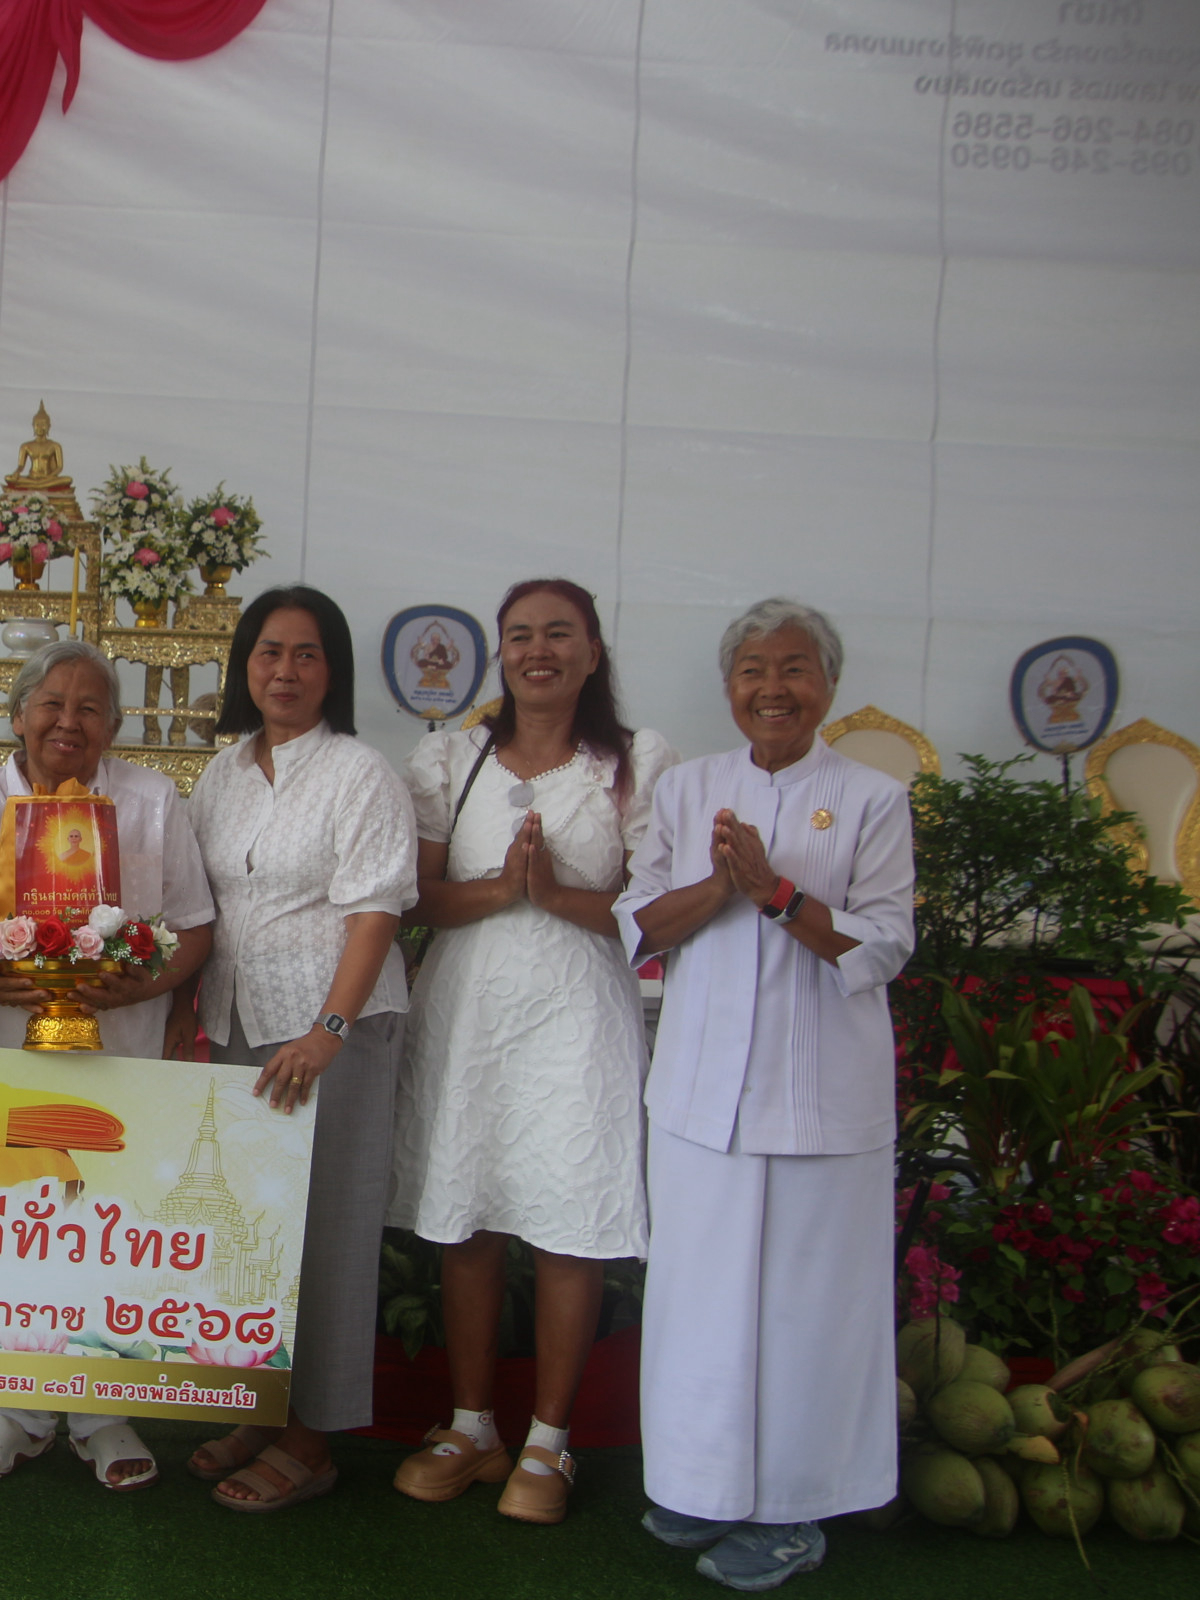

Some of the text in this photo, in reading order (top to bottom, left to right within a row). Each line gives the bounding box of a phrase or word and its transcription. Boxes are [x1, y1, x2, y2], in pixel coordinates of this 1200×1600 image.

[104, 1295, 276, 1345] ๒๕๖๘
[94, 1374, 256, 1407] หลวงพ่อธัมมชโย
